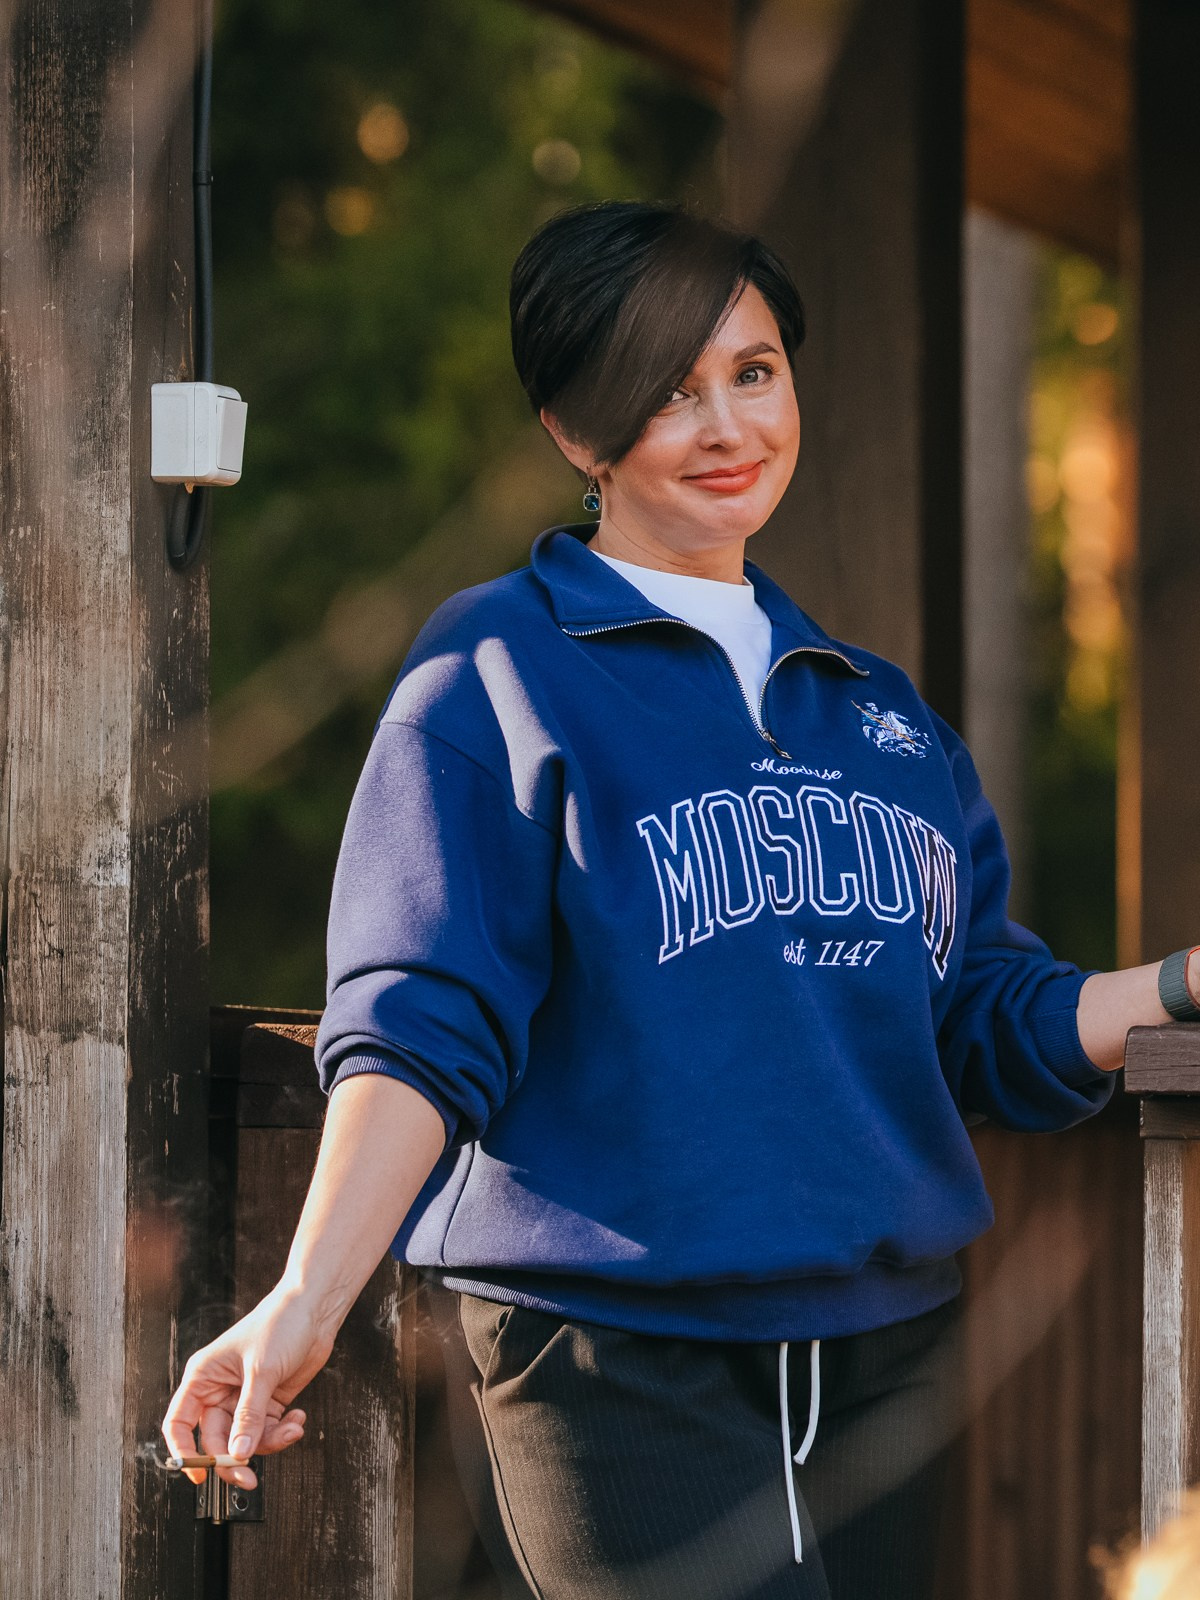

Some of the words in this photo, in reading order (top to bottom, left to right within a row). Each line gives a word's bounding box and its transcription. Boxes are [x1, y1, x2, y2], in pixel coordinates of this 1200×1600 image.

[636, 785, 957, 981] MOSCOW
[783, 938, 806, 966] est
[814, 940, 885, 967] 1147
